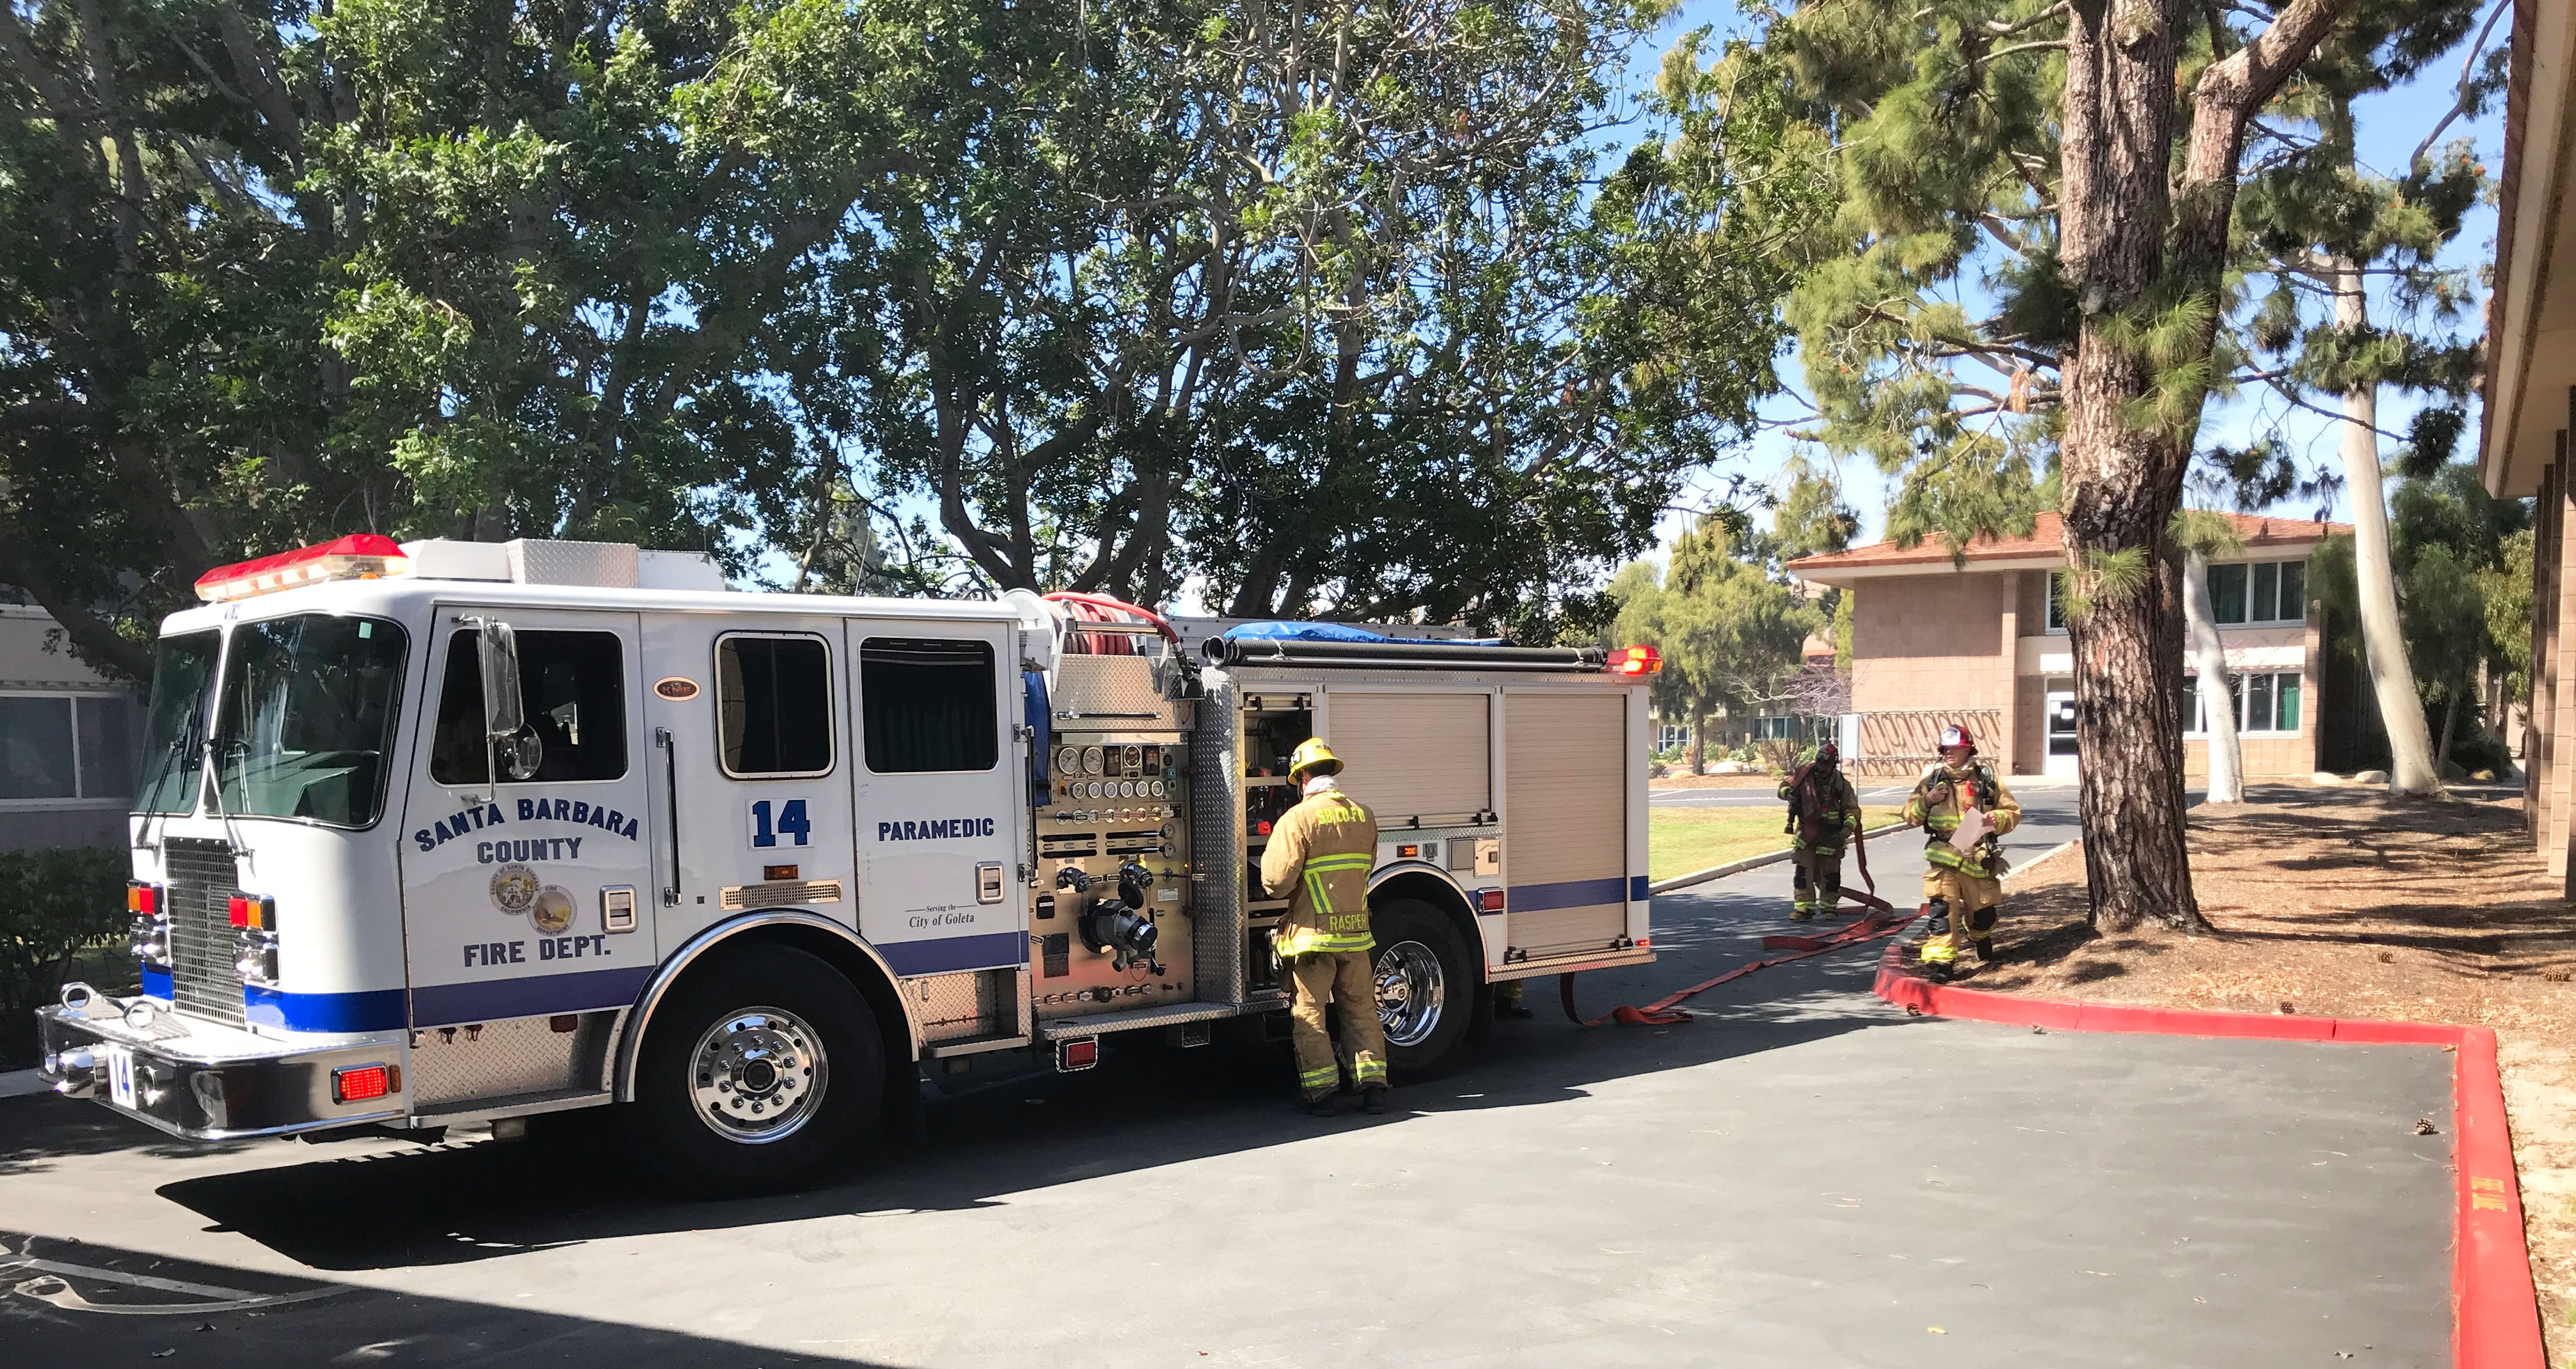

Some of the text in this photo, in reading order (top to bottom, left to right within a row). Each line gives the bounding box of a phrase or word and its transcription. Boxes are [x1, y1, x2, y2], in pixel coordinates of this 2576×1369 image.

[414, 798, 638, 852] SANTA BARBARA
[752, 799, 811, 847] 14
[1315, 806, 1333, 825] SB
[878, 818, 994, 842] PARAMEDIC
[477, 836, 583, 863] COUNTY
[490, 874, 499, 895] COUNTY
[526, 868, 540, 891] BARBARA
[501, 905, 531, 914] CALIFORNIA
[909, 913, 975, 929] City of Goleta
[536, 924, 570, 935] DEPARTMENT
[1329, 914, 1367, 931] RASPER
[464, 934, 611, 967] FIRE DEPT.
[113, 1054, 130, 1101] 14
